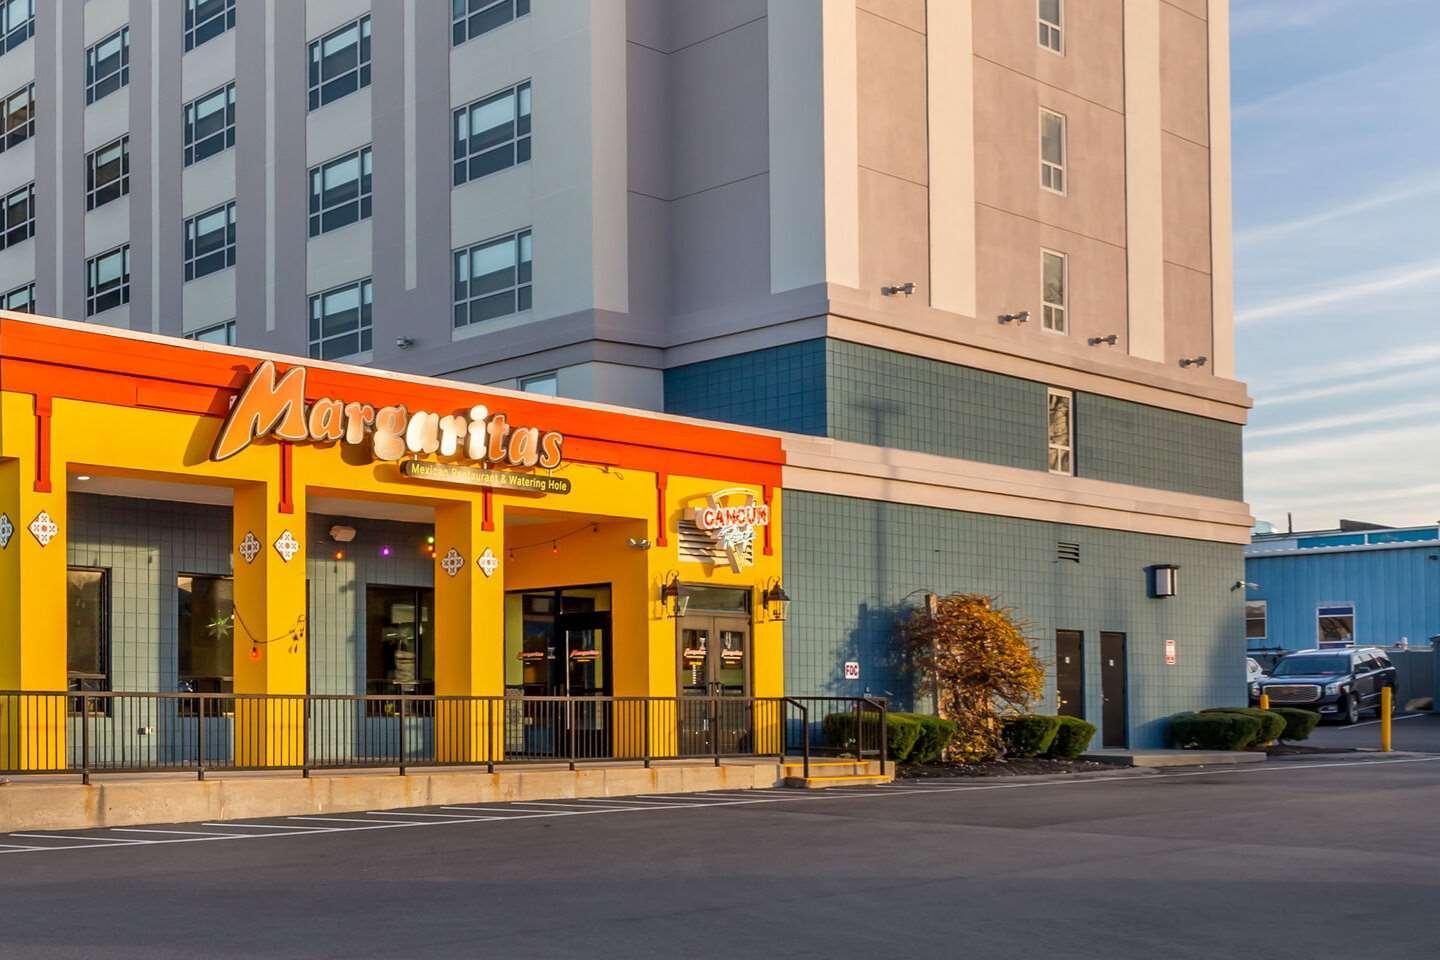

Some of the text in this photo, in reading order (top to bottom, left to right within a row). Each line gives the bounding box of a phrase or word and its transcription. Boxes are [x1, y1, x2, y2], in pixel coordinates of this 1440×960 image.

[210, 360, 564, 469] Margaritas
[509, 474, 547, 491] Watering
[548, 478, 568, 492] Hole
